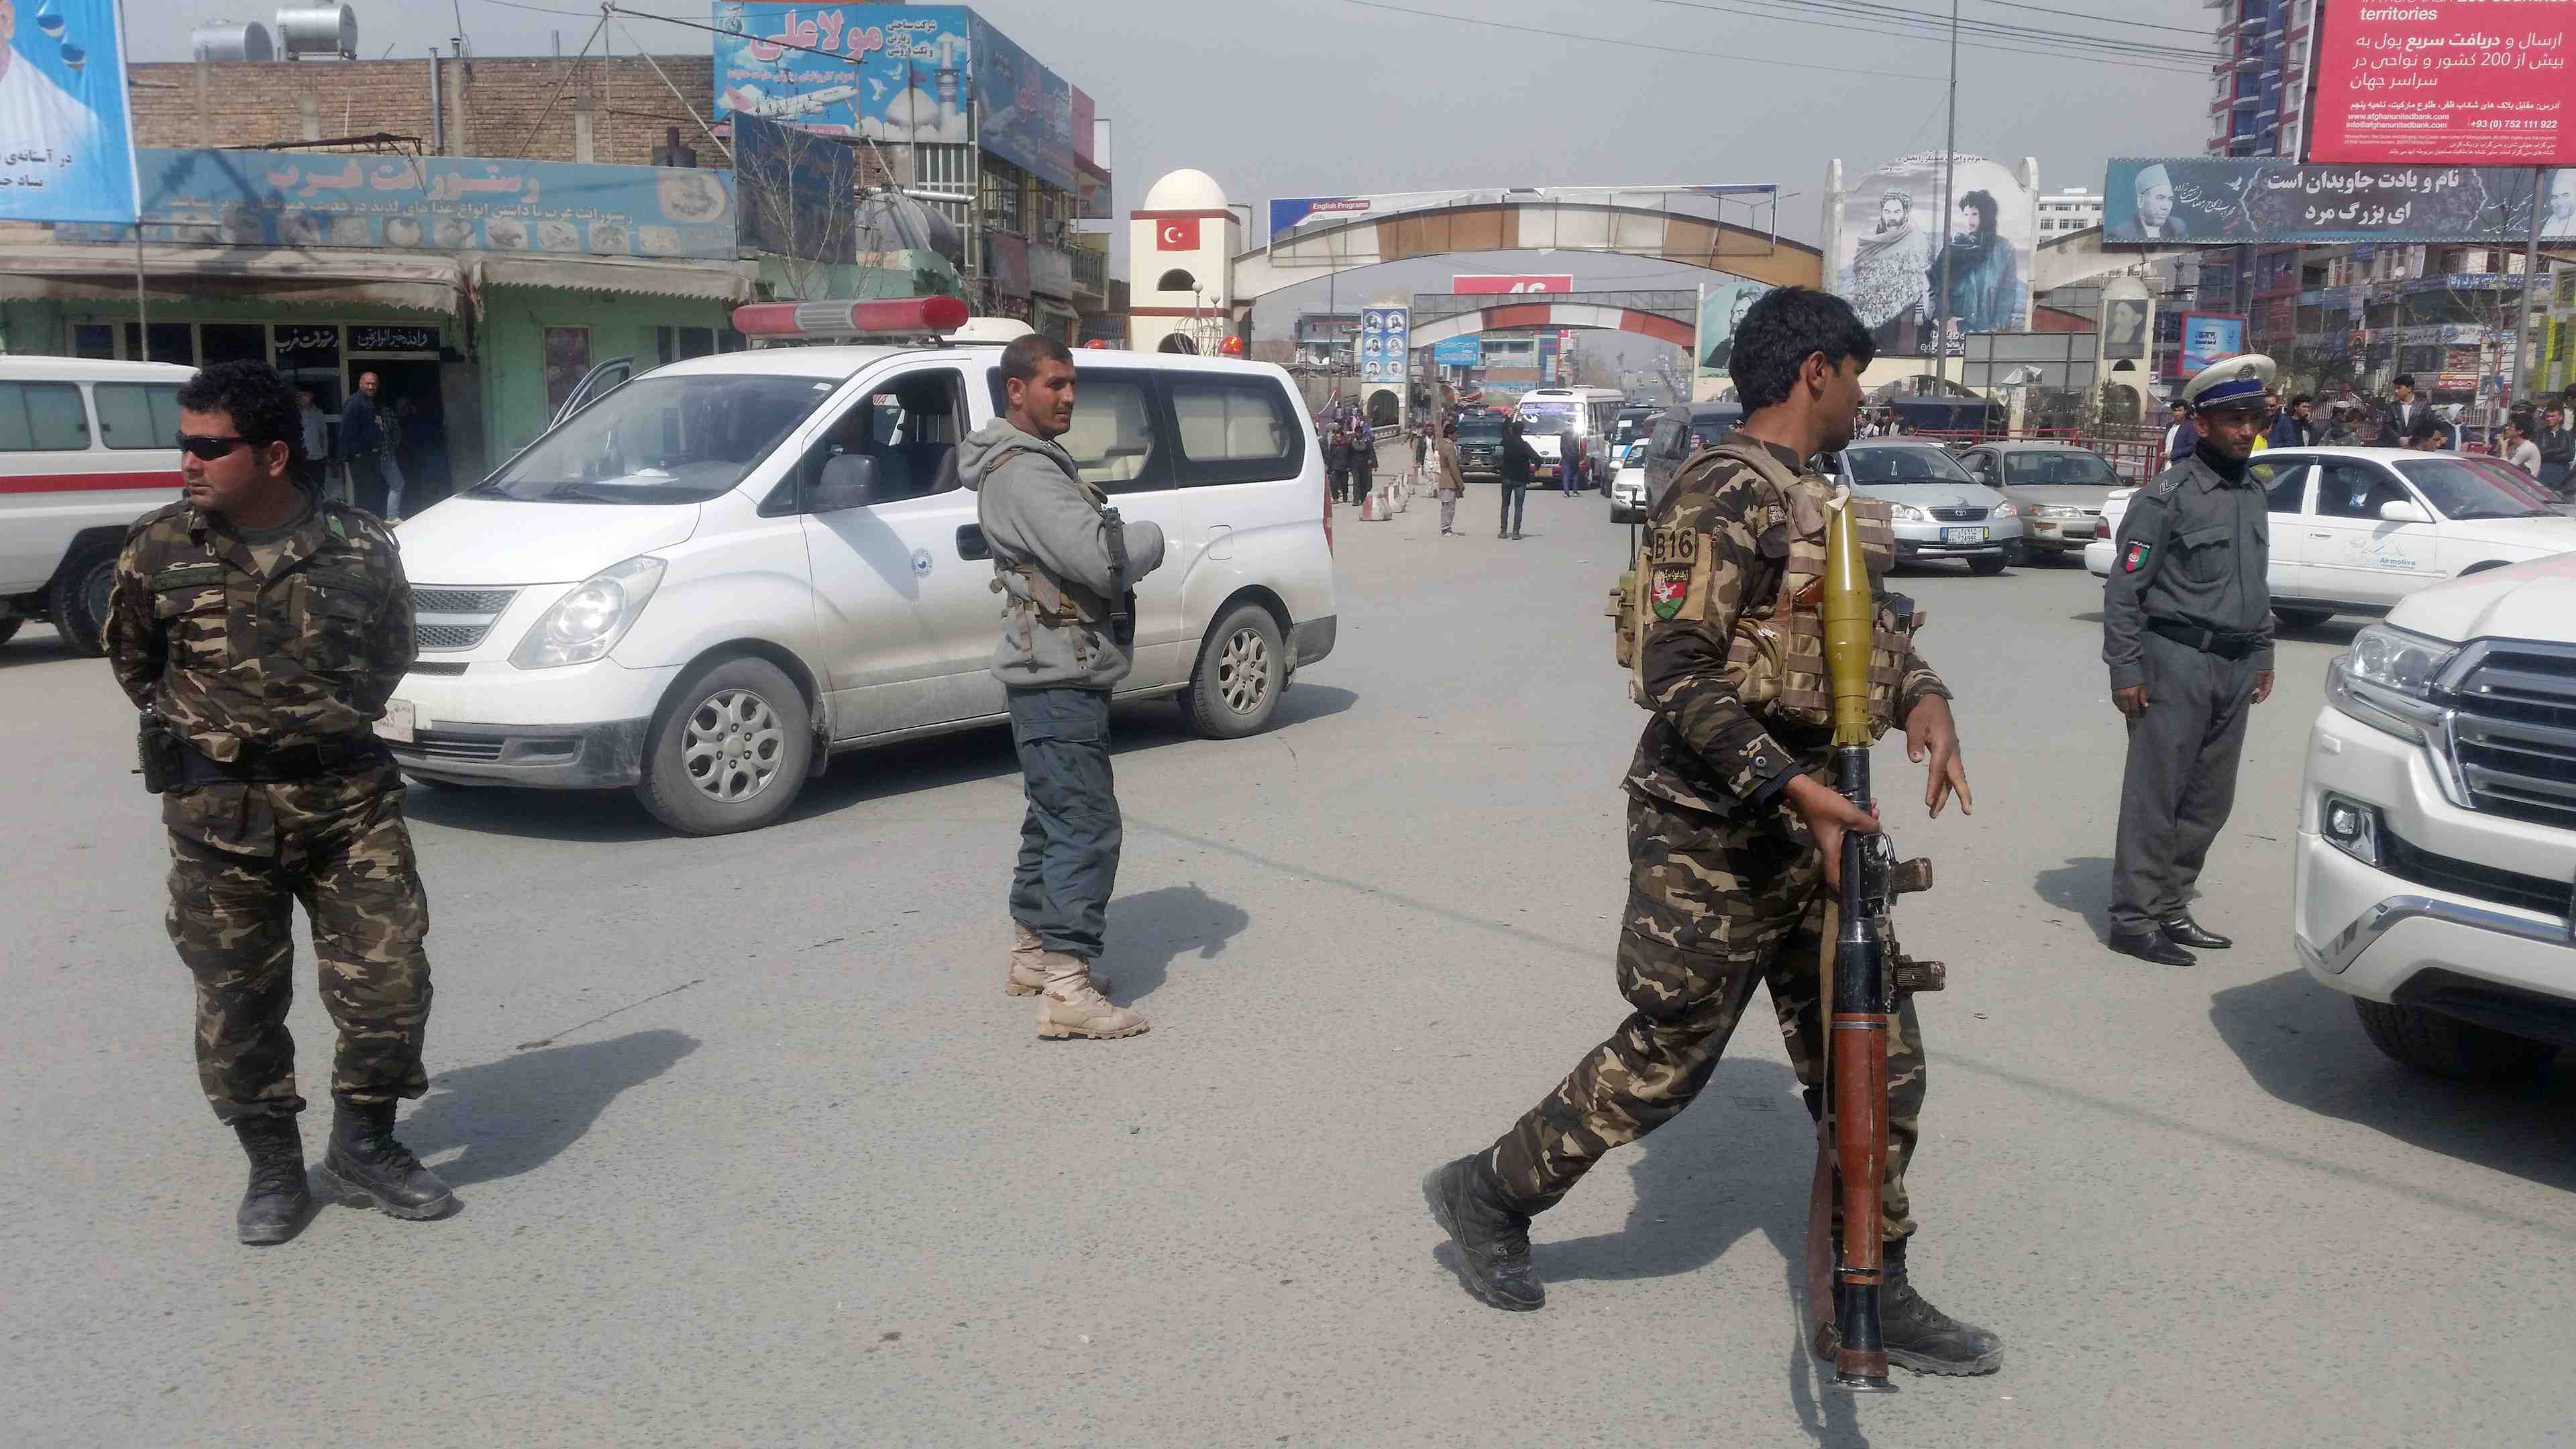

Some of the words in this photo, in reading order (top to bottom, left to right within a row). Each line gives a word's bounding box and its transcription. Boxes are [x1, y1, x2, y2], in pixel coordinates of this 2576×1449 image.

[2360, 7, 2438, 21] territories
[2356, 36, 2371, 49] به
[2375, 33, 2402, 50] پول
[2406, 37, 2445, 52] سریع
[2449, 32, 2500, 49] دریافت
[2506, 37, 2514, 49] و
[2518, 32, 2562, 49] ارسال
[2352, 56, 2367, 69] در
[2371, 52, 2418, 70] نواحی
[2423, 57, 2432, 69] و
[2435, 53, 2477, 69] کشور
[2481, 52, 2511, 66] 200
[2514, 53, 2526, 69] از
[2529, 53, 2564, 70] بیش
[2350, 72, 2385, 91] جهان
[2388, 72, 2438, 89] سراسر
[2346, 121, 2447, 129] info@afghanunitedbank.com
[2347, 113, 2449, 121] www.afghanunitedbank.com
[2471, 119, 2487, 128] +93
[2489, 119, 2502, 129] (0)
[2504, 120, 2520, 128] 752
[2523, 120, 2538, 128] 111
[2540, 120, 2557, 128] 922
[59, 154, 72, 168] در
[2267, 170, 2303, 190] است
[2306, 169, 2374, 194] جاویدان
[2378, 169, 2417, 192] یادت
[2421, 176, 2432, 193] و
[2435, 169, 2459, 193] نام
[1313, 203, 1337, 211] English
[1338, 202, 1369, 210] Programs
[2305, 204, 2334, 225] مرد
[2339, 201, 2384, 225] بزرگ
[2387, 201, 2411, 225] ای
[2379, 557, 2416, 566] Airmotive
